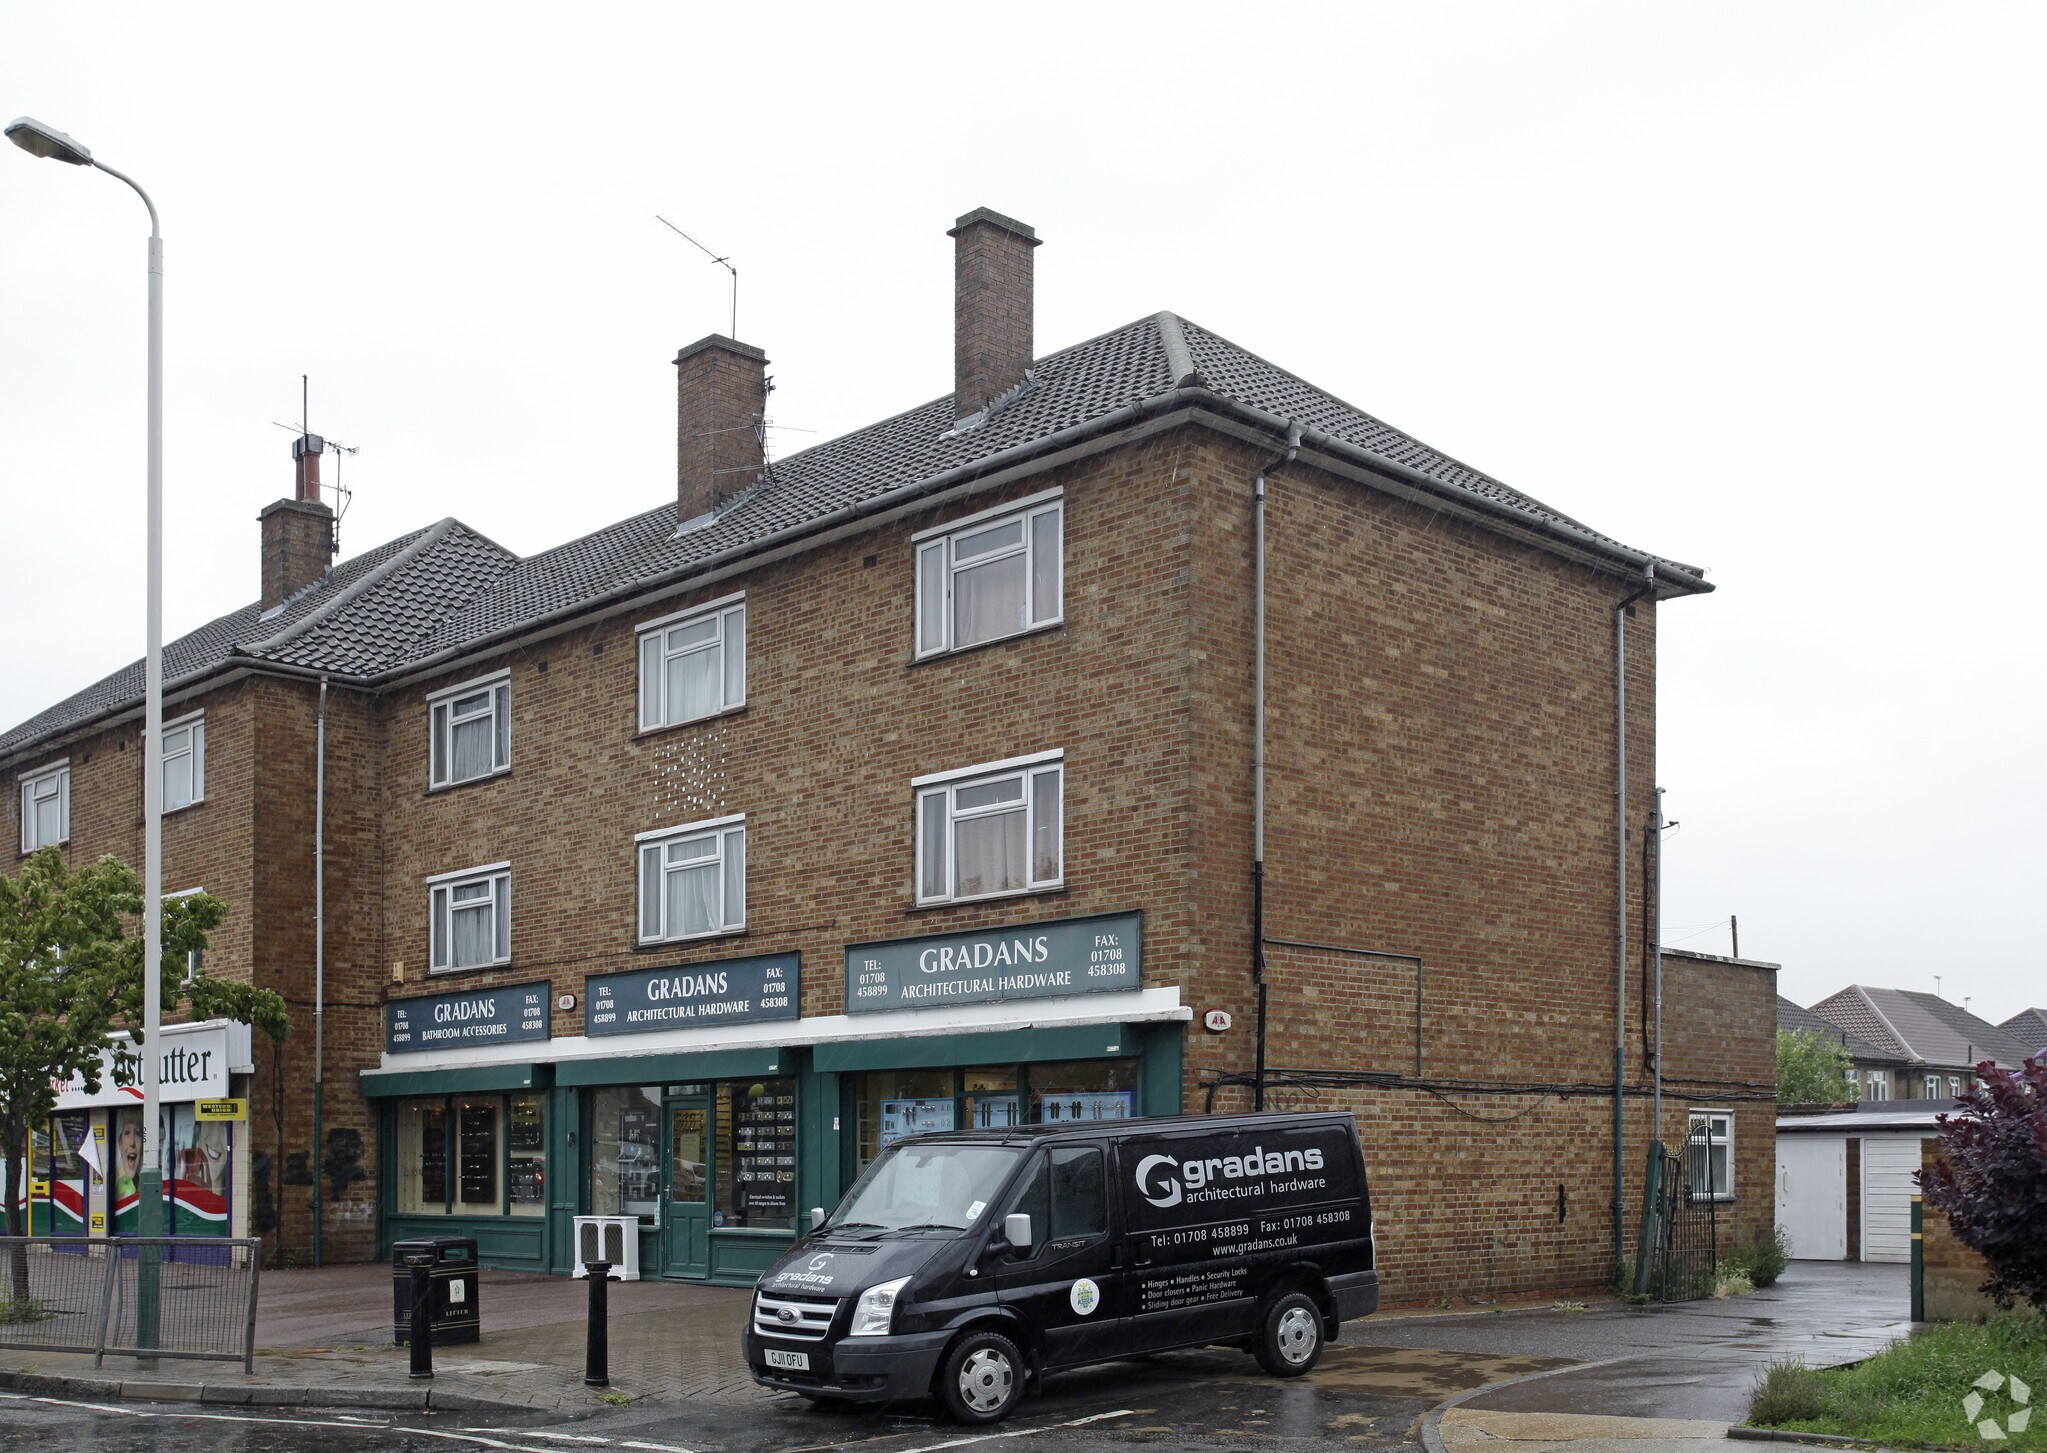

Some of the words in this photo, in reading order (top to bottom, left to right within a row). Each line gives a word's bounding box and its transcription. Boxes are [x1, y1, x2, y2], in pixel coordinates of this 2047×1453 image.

[1095, 934, 1118, 947] FAX:
[919, 936, 1048, 974] GRADANS
[1091, 948, 1122, 962] 01708
[864, 960, 881, 971] TEL:
[1088, 963, 1126, 977] 458308
[766, 968, 783, 978] FAX:
[860, 972, 886, 984] 01708
[599, 987, 612, 996] TEL:
[647, 972, 728, 1000] GRADANS
[763, 982, 786, 993] 01708
[857, 985, 888, 998] 458899
[901, 978, 995, 999] ARCHITECTURAL
[999, 971, 1071, 991] HARDWARE
[526, 994, 538, 1004] FAX:
[596, 1000, 614, 1010] 01708
[760, 997, 788, 1008] 458308
[397, 1010, 407, 1018] TEL:
[434, 999, 496, 1022] GRADANS
[524, 1008, 541, 1017] 01708
[627, 1005, 696, 1022] ARCHITECTURAL
[698, 1000, 750, 1016] HARDWARE
[522, 1020, 542, 1030] 458308
[594, 1013, 616, 1024] 458899
[394, 1022, 409, 1030] 01708
[422, 1028, 460, 1041] BATHROOM
[462, 1024, 508, 1037] ACCESSORIES
[1183, 1146, 1324, 1189] gradans
[1186, 1182, 1265, 1204] architectural
[1270, 1177, 1326, 1194] hardware
[1151, 1234, 1170, 1247] Tel:
[1174, 1230, 1207, 1244] 01708
[1211, 1224, 1250, 1239] 458899
[1260, 1220, 1280, 1232] Fax:
[1284, 1216, 1314, 1229] 01708
[1316, 1210, 1350, 1224] 458308
[1212, 1234, 1298, 1256] www.gradans.co.uk
[775, 1271, 834, 1284] gradans
[1148, 1279, 1169, 1289] Hinges
[1176, 1274, 1200, 1284] Handles
[1206, 1270, 1230, 1280] Security
[1232, 1268, 1248, 1276] Locks
[800, 1283, 826, 1292] hardware
[1148, 1291, 1163, 1299] Door
[1164, 1287, 1185, 1297] closers
[1192, 1284, 1208, 1292] Panic
[1210, 1280, 1237, 1290] Hardware
[1148, 1300, 1169, 1310] Sliding
[1170, 1298, 1184, 1306] door
[1186, 1296, 1200, 1306] gear
[1206, 1292, 1218, 1300] Free
[1220, 1289, 1244, 1298] Delivery
[786, 1354, 802, 1366] OFU
